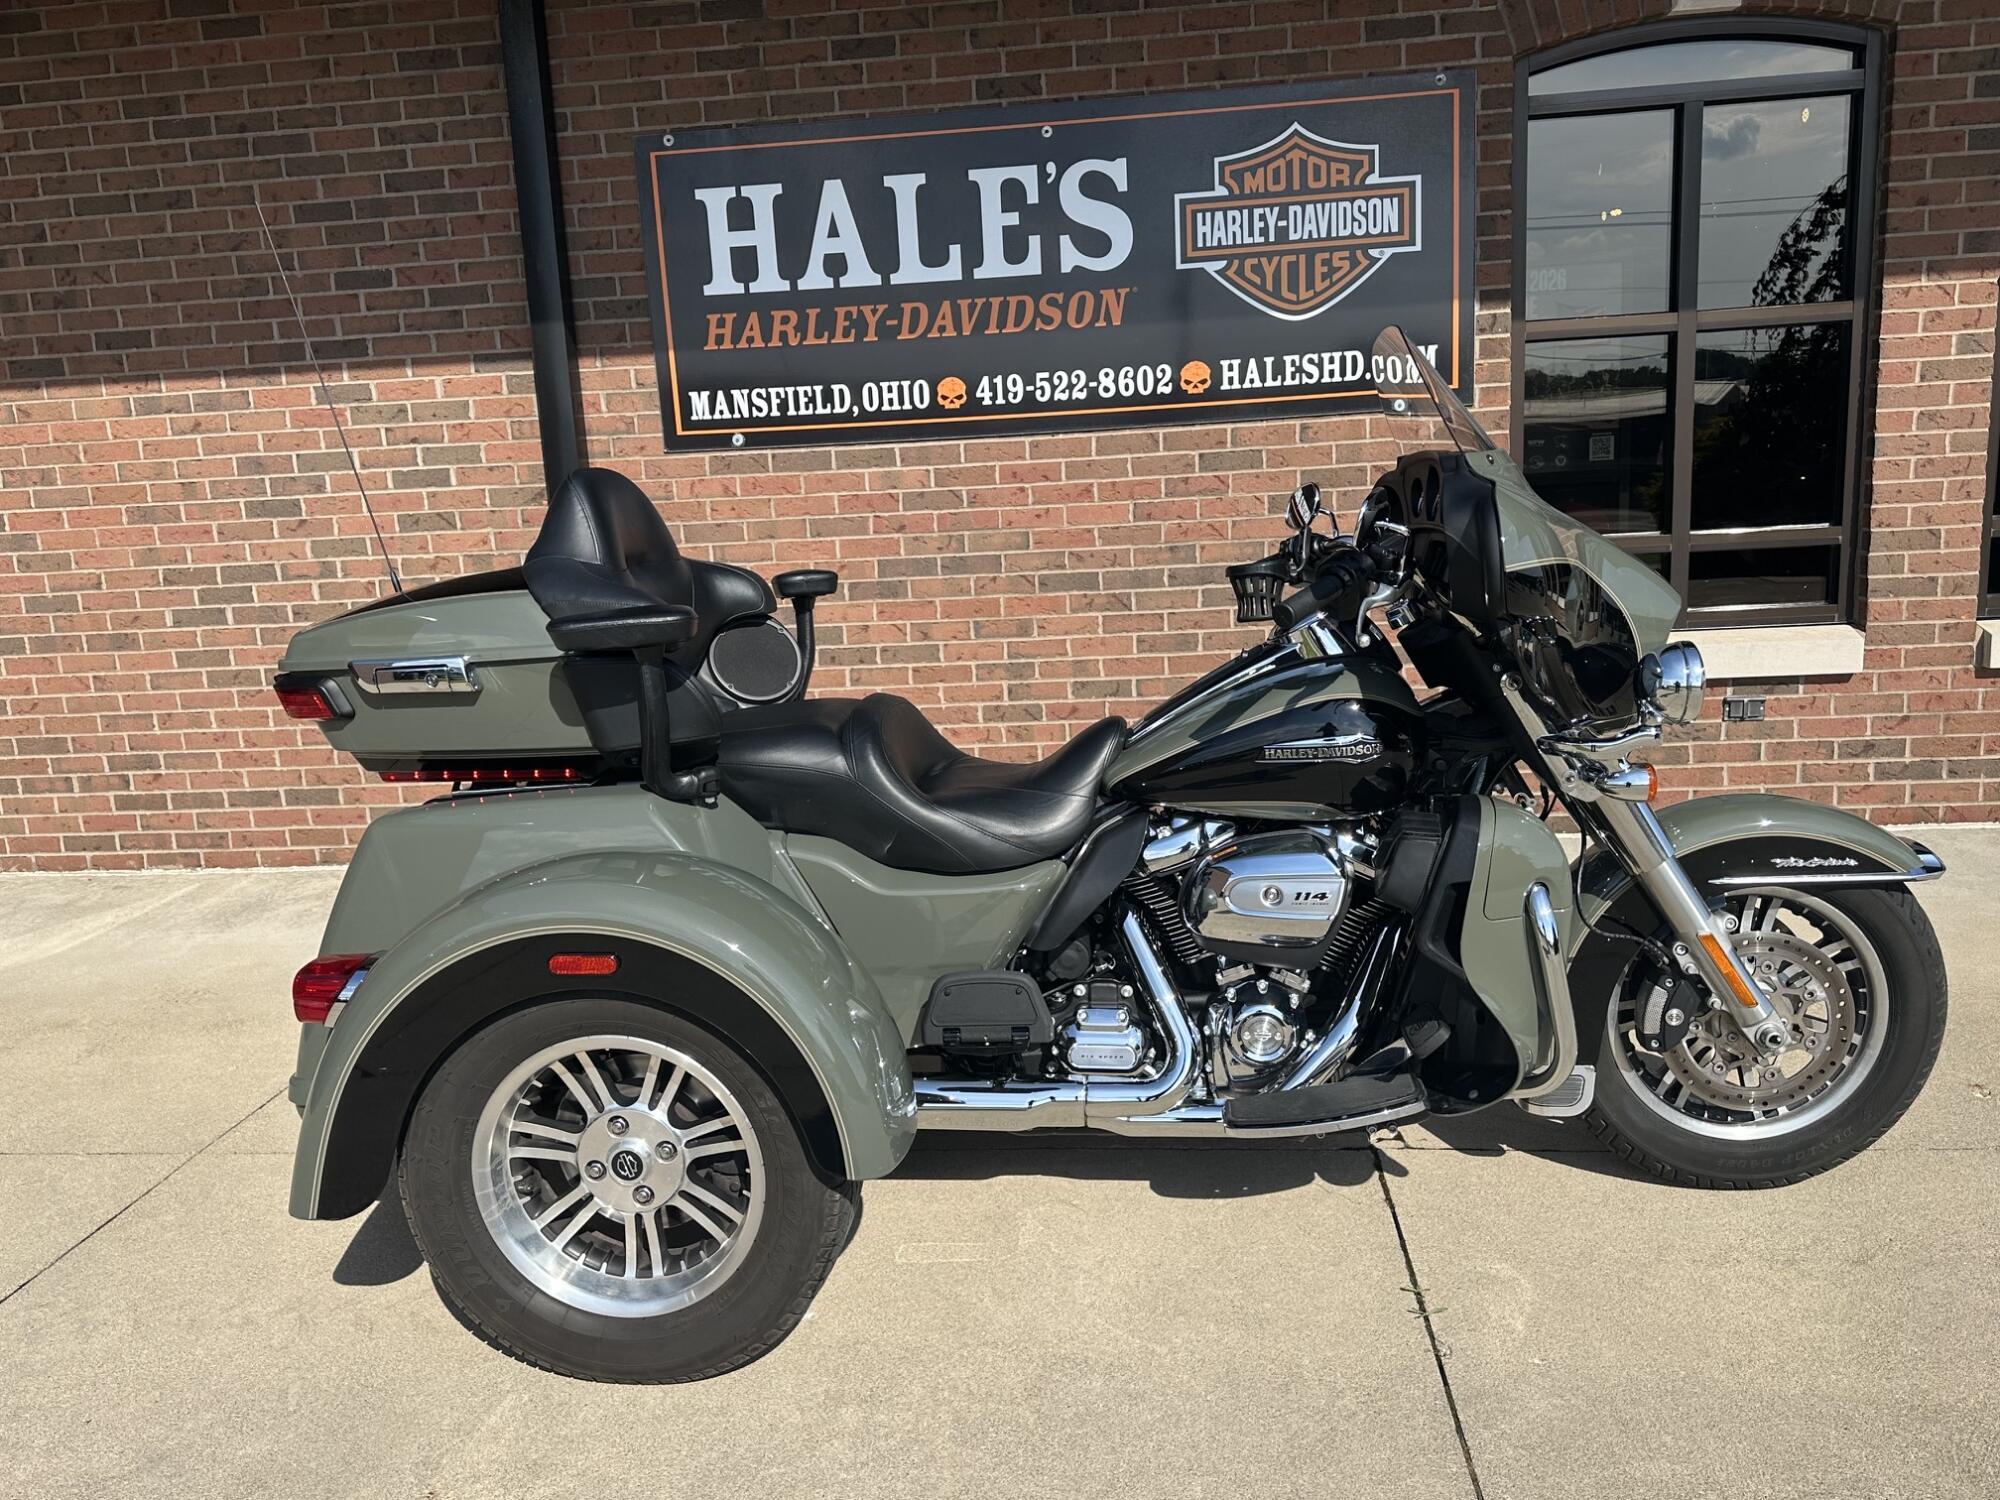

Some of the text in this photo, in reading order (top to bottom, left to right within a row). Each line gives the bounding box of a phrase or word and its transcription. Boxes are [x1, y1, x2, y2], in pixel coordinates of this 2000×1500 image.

[1243, 148, 1350, 194] MOTOR
[694, 157, 1134, 296] HALE'S
[1196, 197, 1399, 248] HARLEY-DAVIDSON
[1243, 250, 1350, 302] CYCLES
[702, 287, 1131, 351] HARLEY-DAVIDSON
[975, 363, 1174, 406] 419-522-8602
[1219, 344, 1438, 390] HALESHD.COM
[1294, 892, 1329, 901] 114
